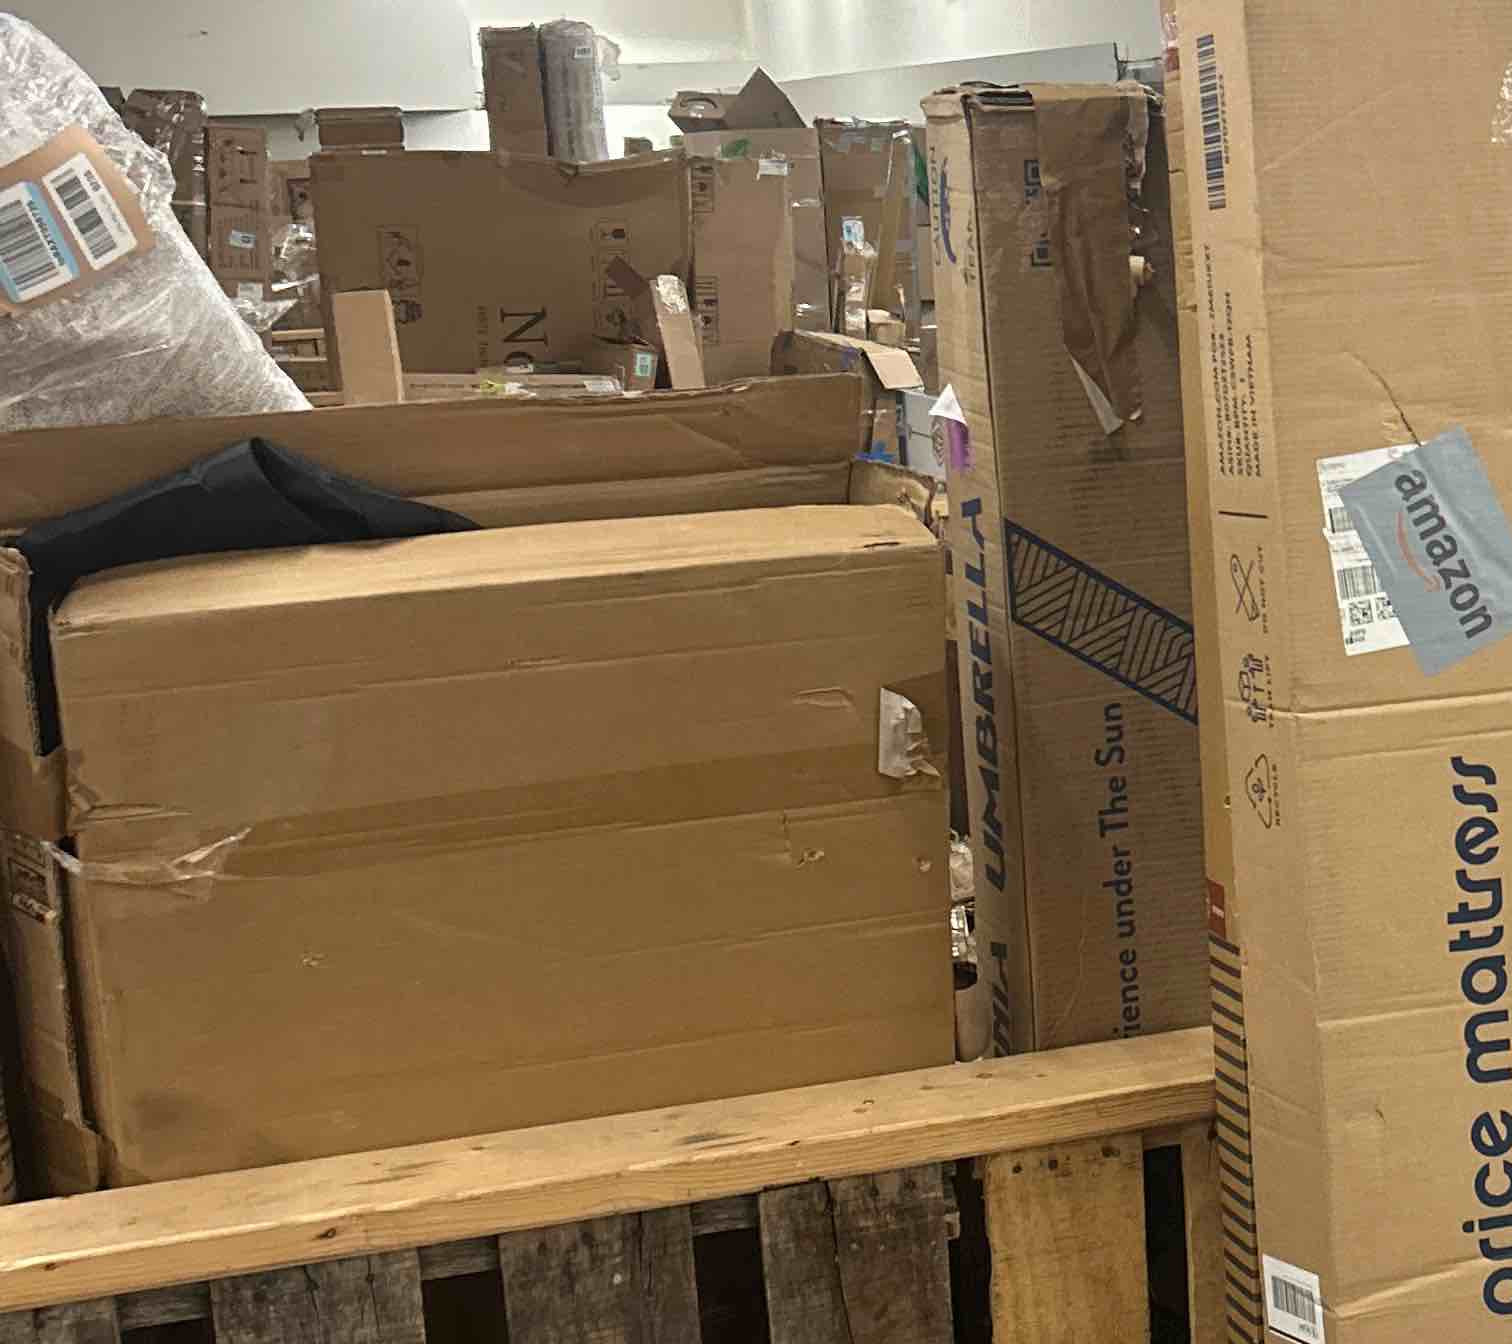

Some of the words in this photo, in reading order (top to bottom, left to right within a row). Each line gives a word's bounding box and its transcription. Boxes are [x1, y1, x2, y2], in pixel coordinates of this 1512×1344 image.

[1395, 470, 1492, 639] amazon
[961, 496, 1006, 891] UMBRELLA
[1094, 702, 1124, 769] Sun
[1098, 776, 1129, 838] The
[1101, 846, 1137, 940] under
[1447, 755, 1512, 1084] mattress
